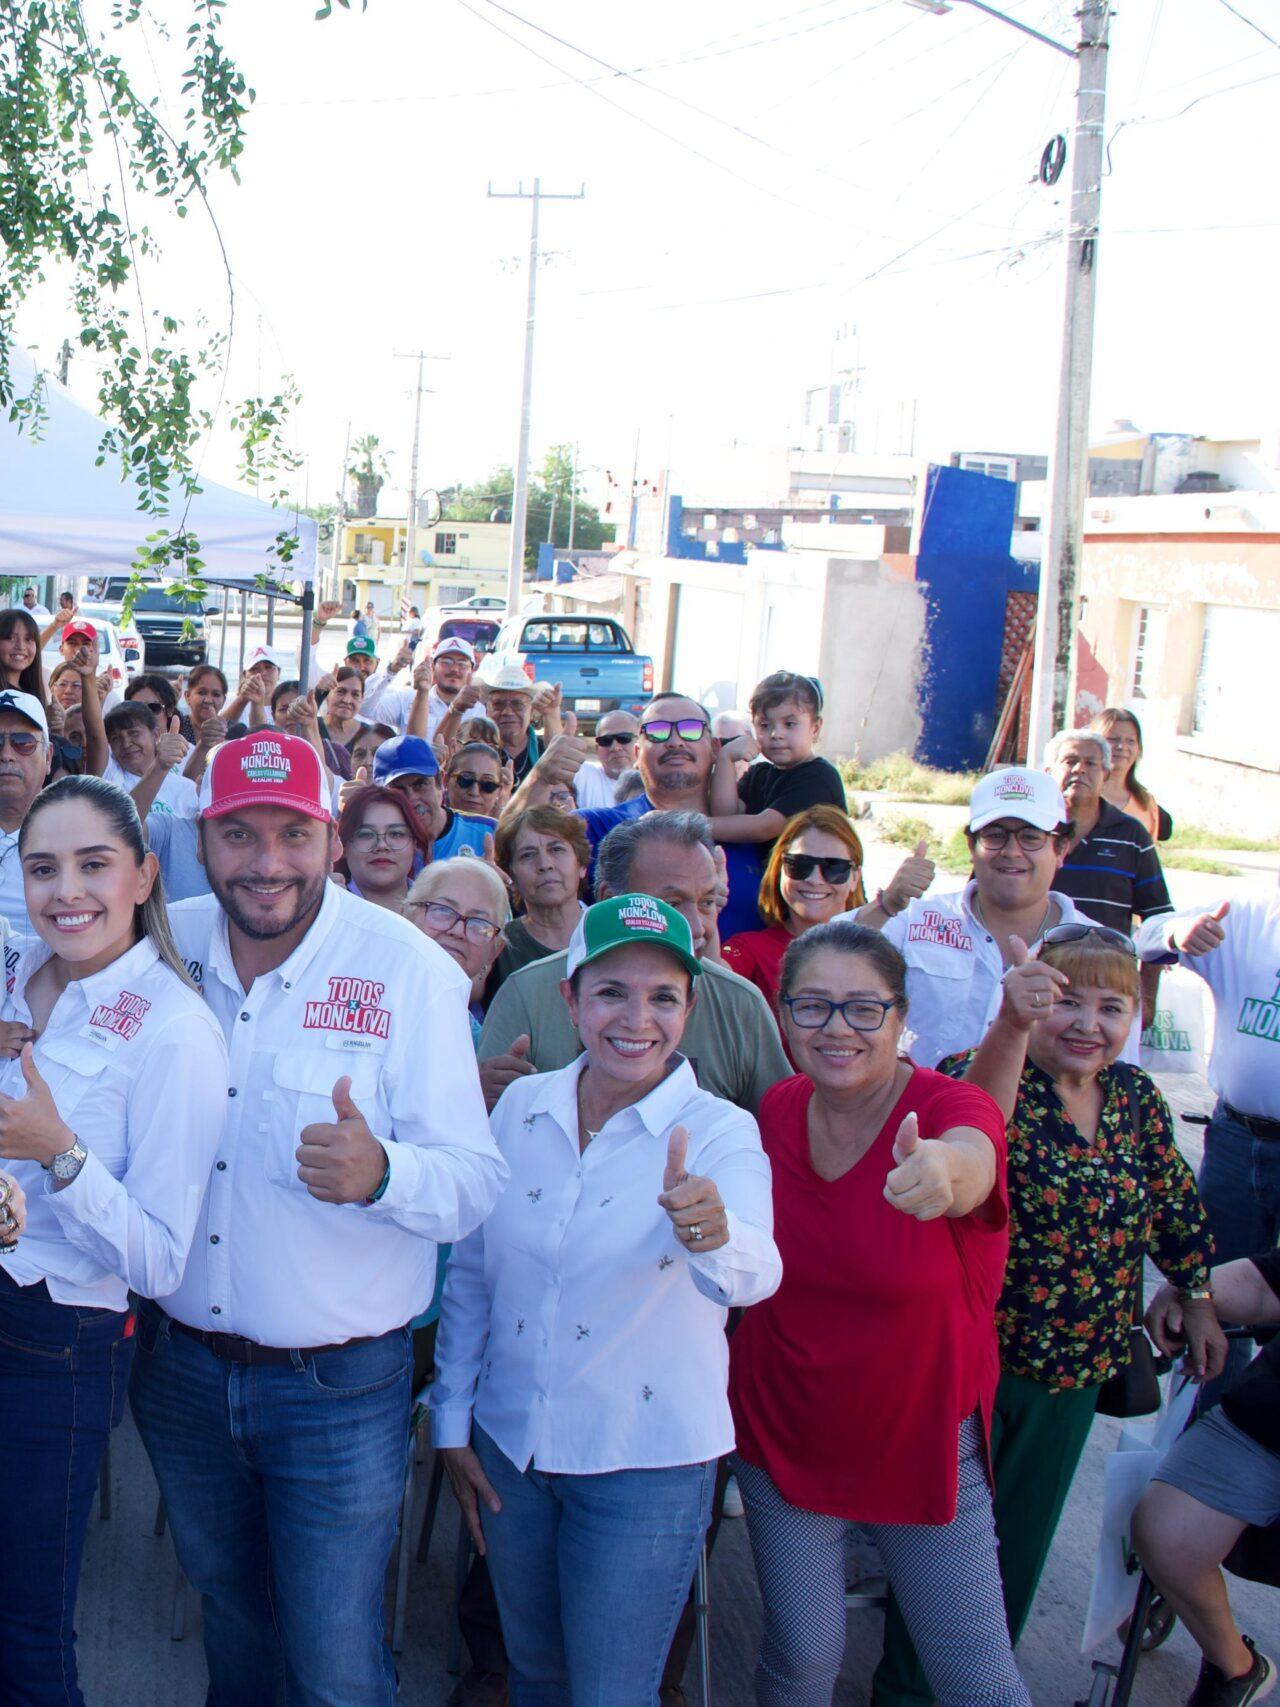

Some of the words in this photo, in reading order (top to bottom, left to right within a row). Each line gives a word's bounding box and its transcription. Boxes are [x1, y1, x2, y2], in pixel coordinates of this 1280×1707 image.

[252, 741, 282, 755] TODOS
[241, 755, 292, 772] MONCLOVA
[618, 906, 669, 927] MONCLOVA
[908, 924, 974, 952] MONCLOVA
[328, 976, 385, 1008] TODOS
[303, 1002, 391, 1040] MONCLOVA
